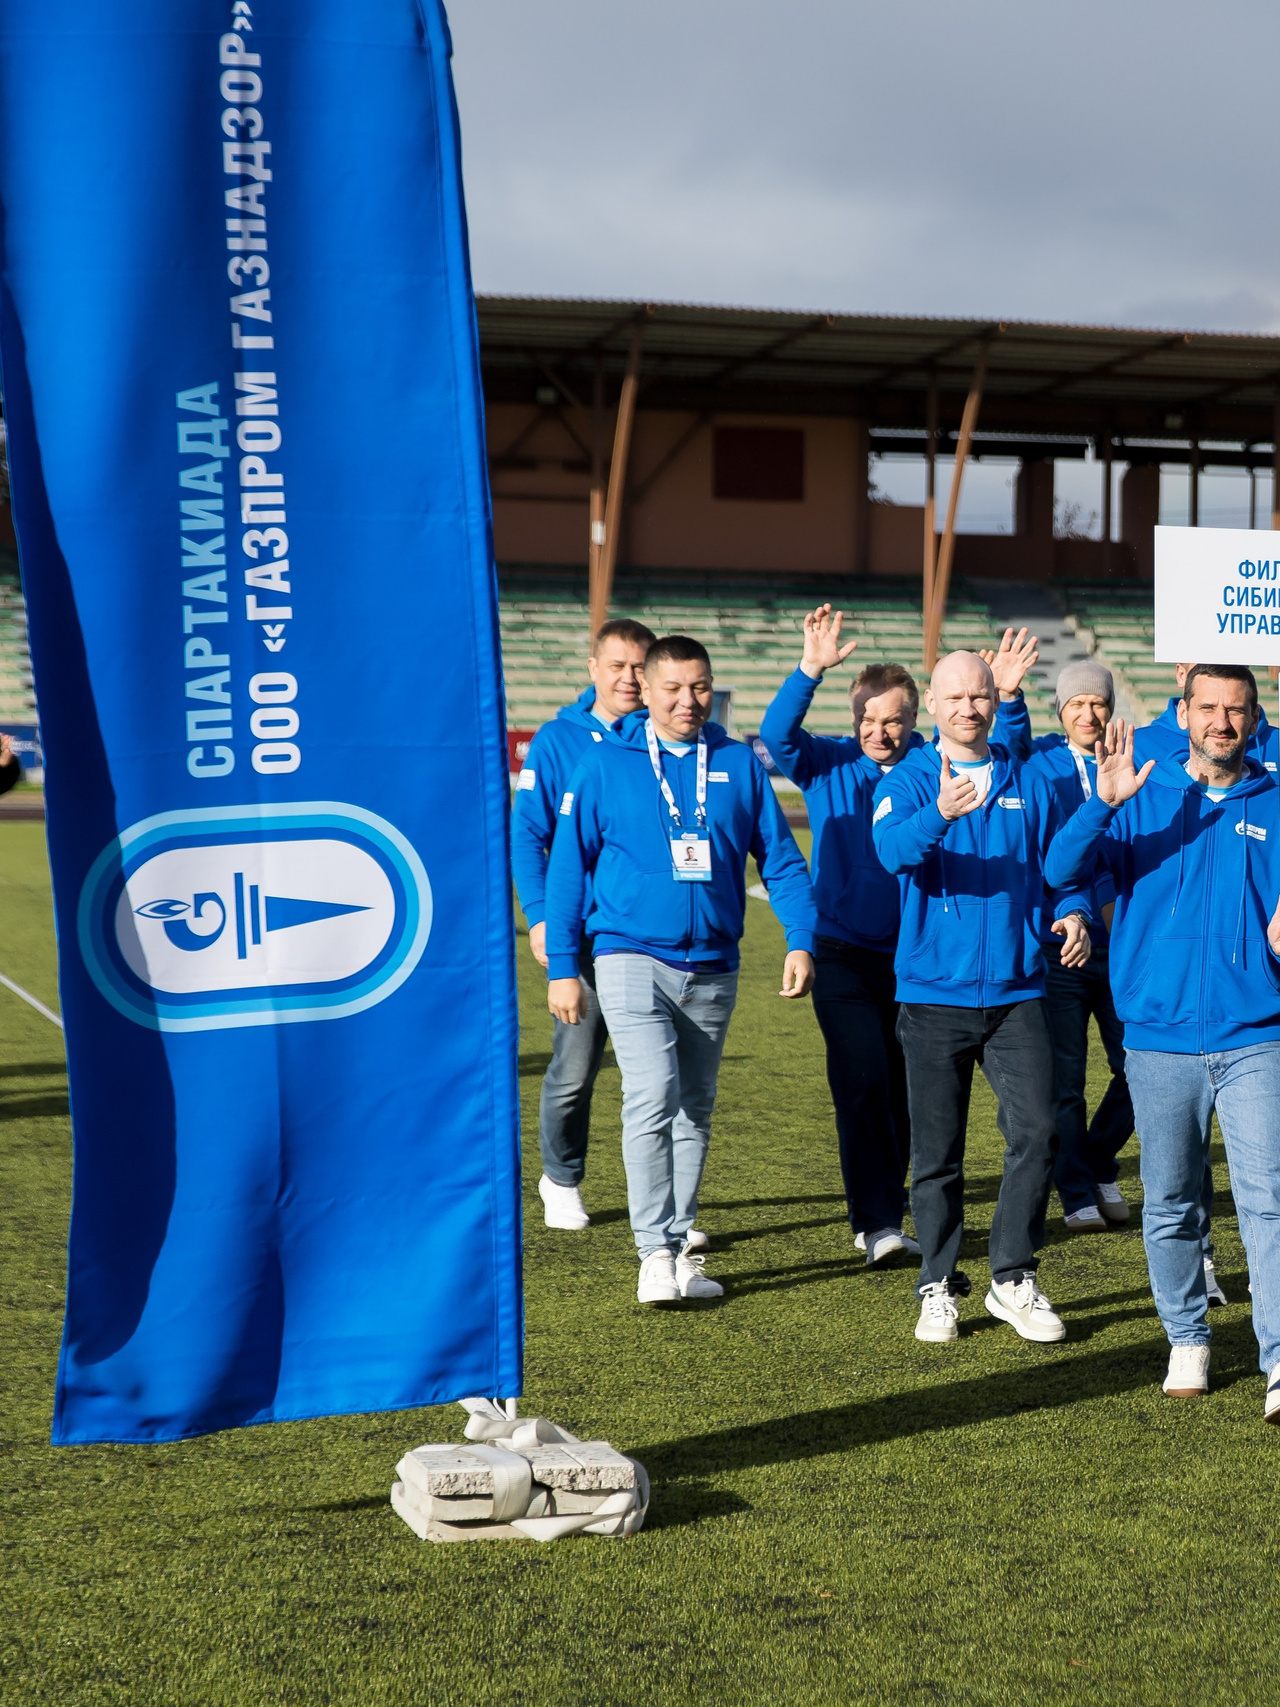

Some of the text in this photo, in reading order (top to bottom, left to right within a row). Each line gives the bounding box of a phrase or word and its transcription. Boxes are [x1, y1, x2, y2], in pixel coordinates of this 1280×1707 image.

[176, 381, 236, 778] СПАРТАКИАДА
[219, 1, 302, 775] ООО «ГАЗПРОМ ГАЗНАДЗОР»
